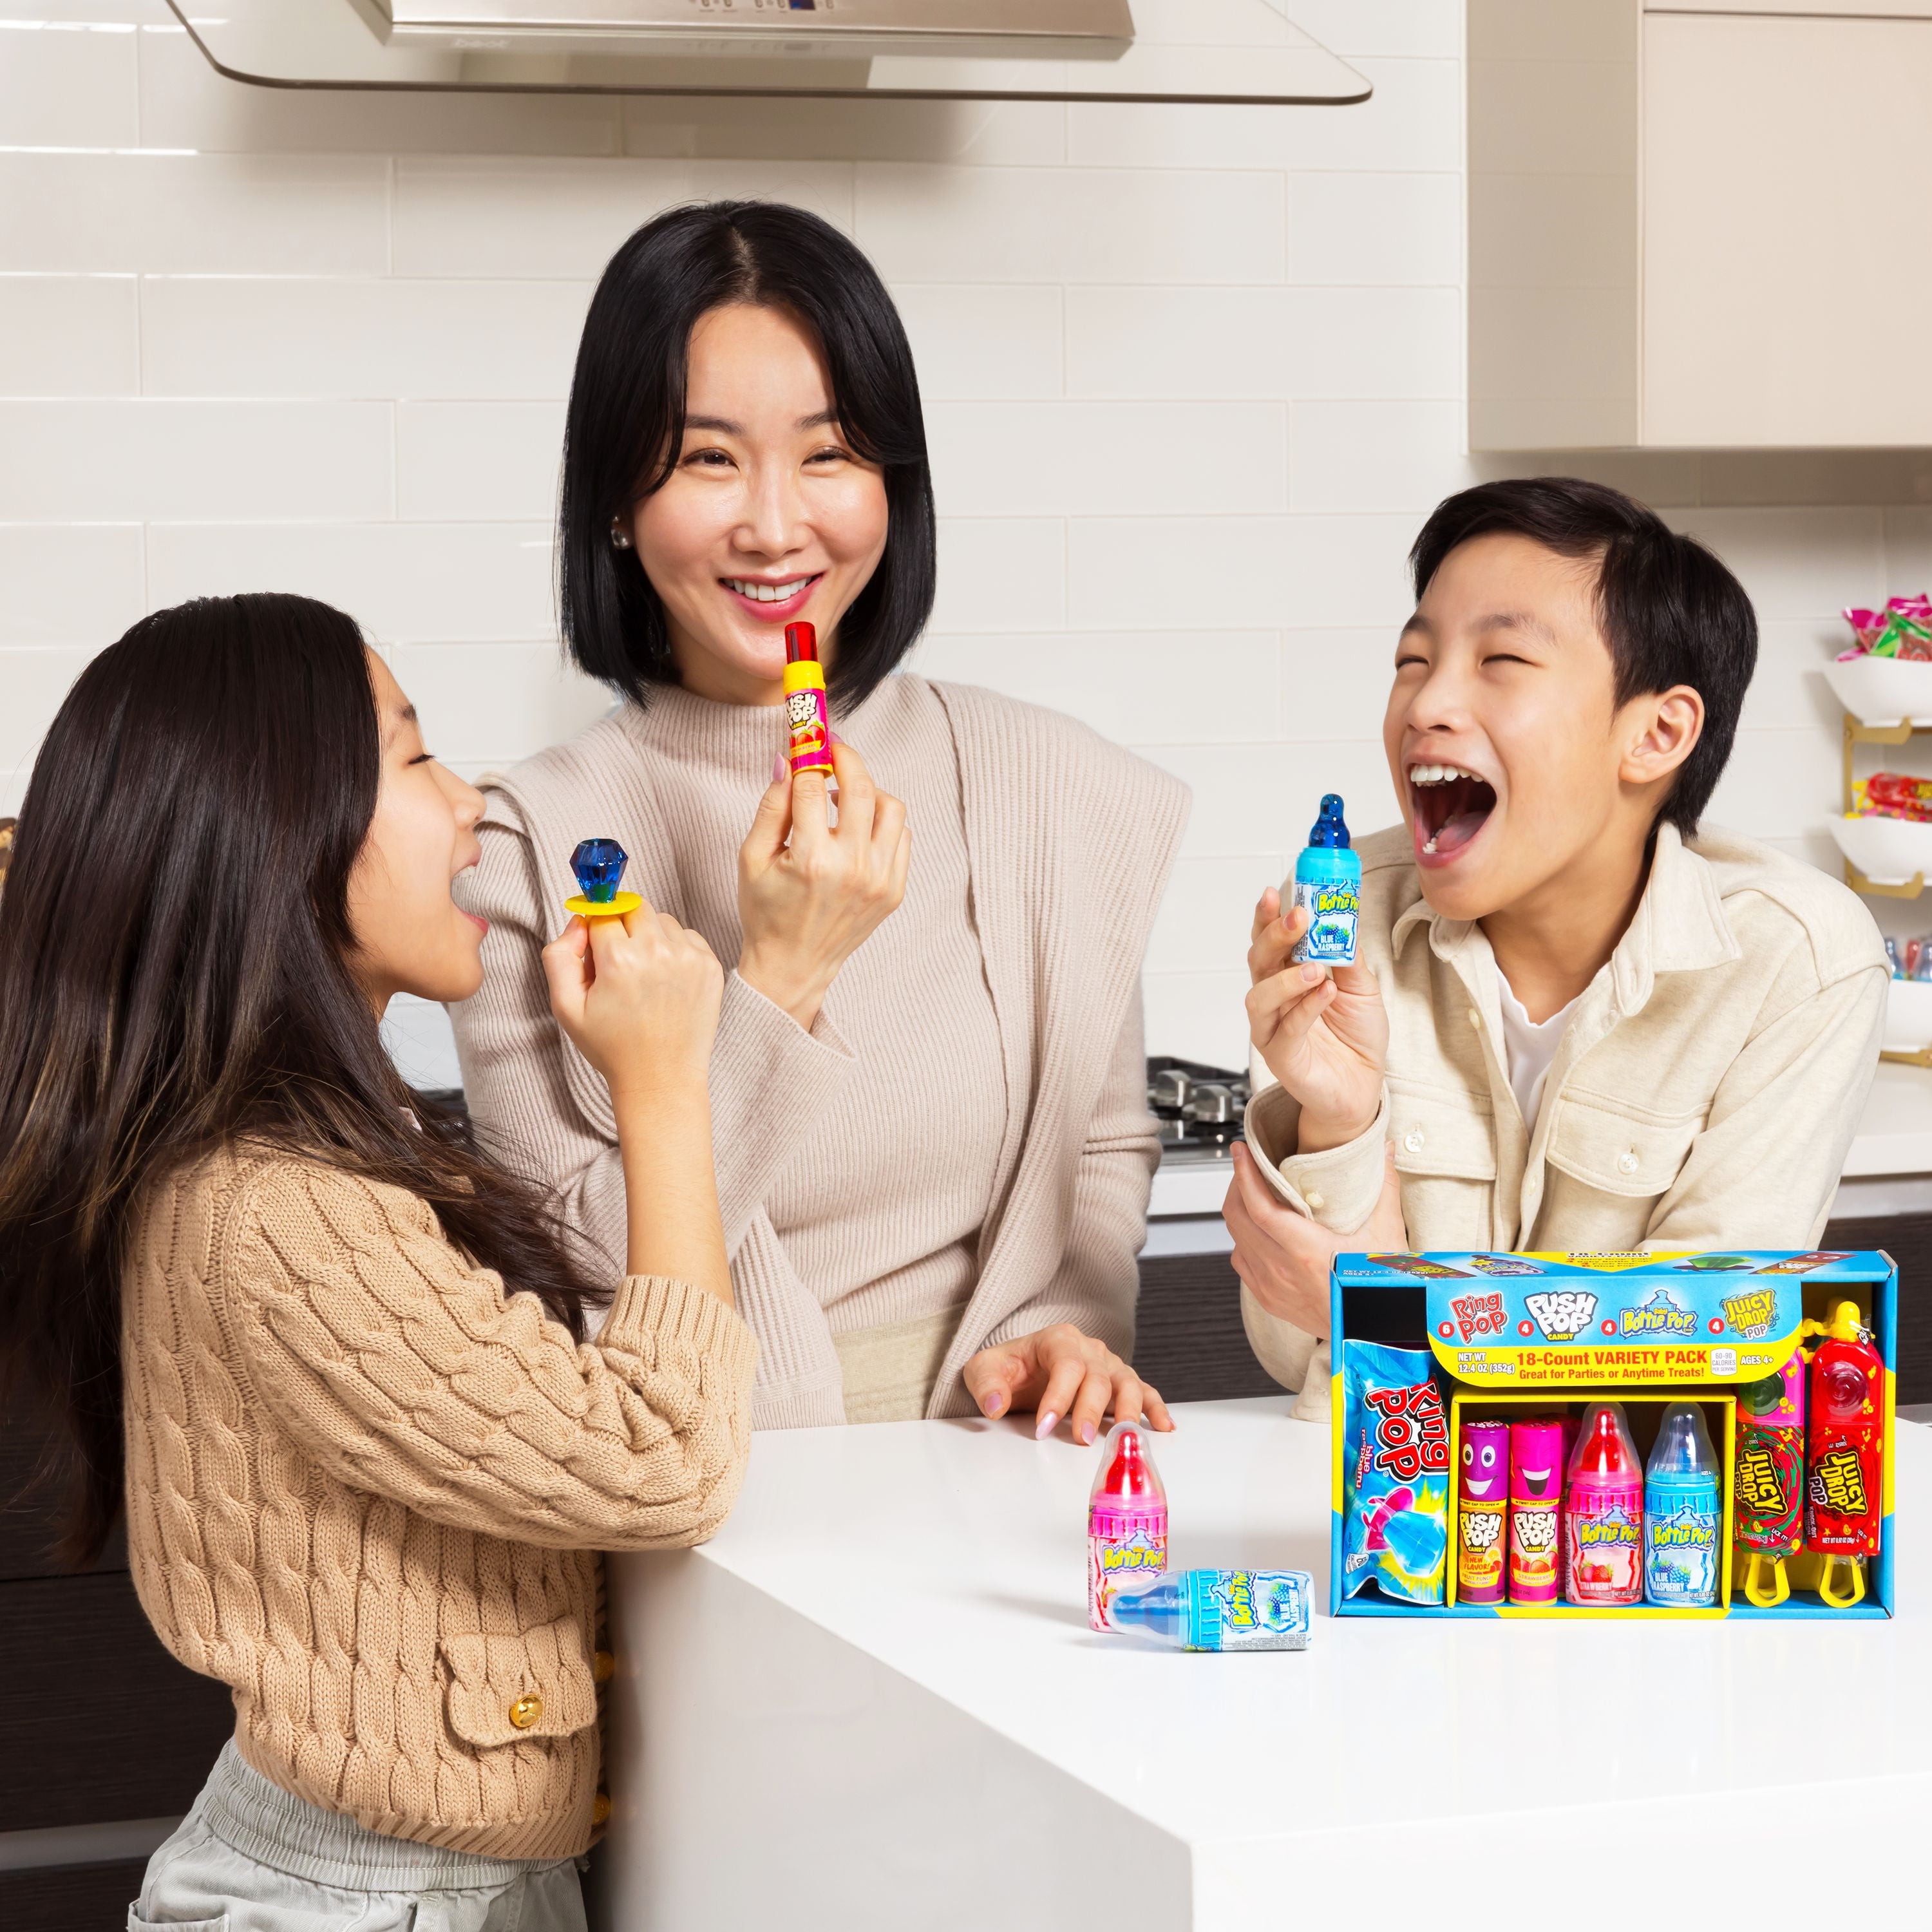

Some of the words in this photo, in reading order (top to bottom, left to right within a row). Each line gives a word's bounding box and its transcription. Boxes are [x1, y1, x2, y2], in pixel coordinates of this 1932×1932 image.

[786, 693, 817, 711] USH
[1320, 934, 1334, 943] BLUE
[1450, 1292, 1501, 1319] Ring
[1525, 1293, 1597, 1319] PUSH
[1727, 1292, 1772, 1323] JUICY
[1521, 1323, 1530, 1334] 4
[1537, 1311, 1591, 1336] POP
[1604, 1322, 1613, 1332] 4
[1712, 1321, 1720, 1331] 4
[1736, 1308, 1768, 1330] DROP
[1443, 1324, 1451, 1334] 6
[1747, 1325, 1766, 1339] POP
[1457, 1352, 1475, 1362] NET
[1474, 1352, 1486, 1362] WT
[1517, 1352, 1589, 1366] 18-Count
[1594, 1350, 1660, 1365] VARIETY
[1665, 1350, 1707, 1364] PACK
[1740, 1355, 1761, 1365] AGES
[1763, 1355, 1774, 1365] 4+
[1458, 1363, 1476, 1374] 12.4
[1477, 1363, 1488, 1373] OZ
[1489, 1363, 1515, 1375] (352g)
[1519, 1369, 1548, 1379] Great
[1550, 1369, 1564, 1379] for
[1568, 1368, 1605, 1379] Parties
[1622, 1368, 1665, 1380] Anytime
[1668, 1368, 1705, 1378] Treats!
[1408, 1379, 1449, 1468] Ring
[1364, 1444, 1374, 1473] blue
[1739, 1462, 1759, 1503] DROP
[1745, 1453, 1783, 1511] JUICY
[1810, 1476, 1827, 1504] POP
[1821, 1467, 1849, 1508] DROP
[1830, 1455, 1866, 1511] JUICY
[1459, 1512, 1502, 1531] PUSH
[1513, 1512, 1557, 1532] PUSH
[1463, 1528, 1499, 1547] POP
[1519, 1528, 1555, 1548] POP
[1654, 1572, 1669, 1582] BLUE
[1653, 1582, 1685, 1592] RASPBERRY
[1280, 1603, 1290, 1620] BLUE
